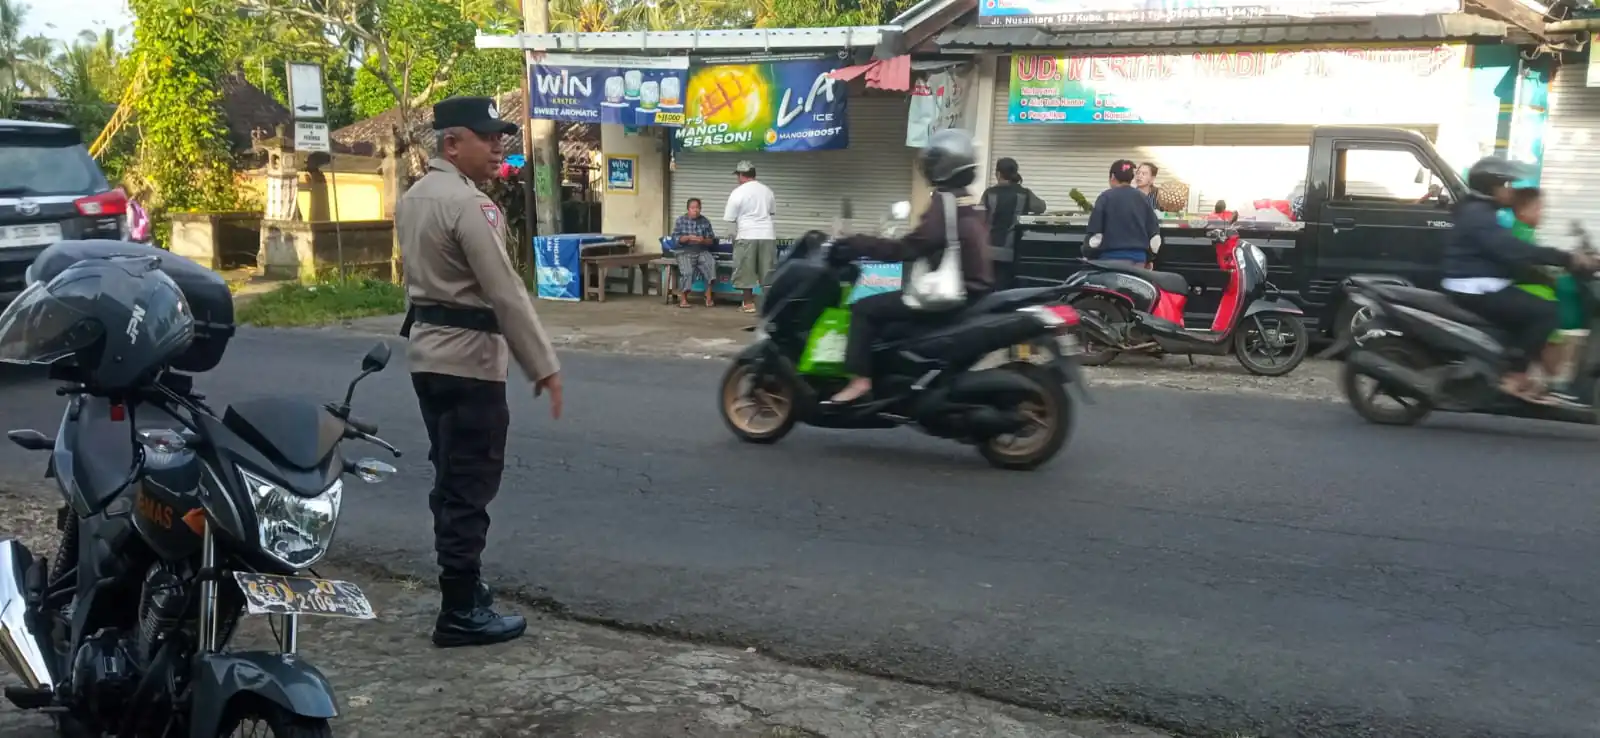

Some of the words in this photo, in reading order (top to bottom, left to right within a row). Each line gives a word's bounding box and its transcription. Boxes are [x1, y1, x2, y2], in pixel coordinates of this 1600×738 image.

[1018, 55, 1061, 81] UD.
[536, 70, 592, 97] WIN
[534, 107, 559, 116] SWEET
[560, 108, 599, 117] AROMATIC
[813, 113, 834, 122] ICE
[675, 123, 728, 139] MANGO
[779, 126, 842, 139] MANGOBOOST
[683, 131, 752, 148] SEASON!
[126, 304, 146, 344] JPN
